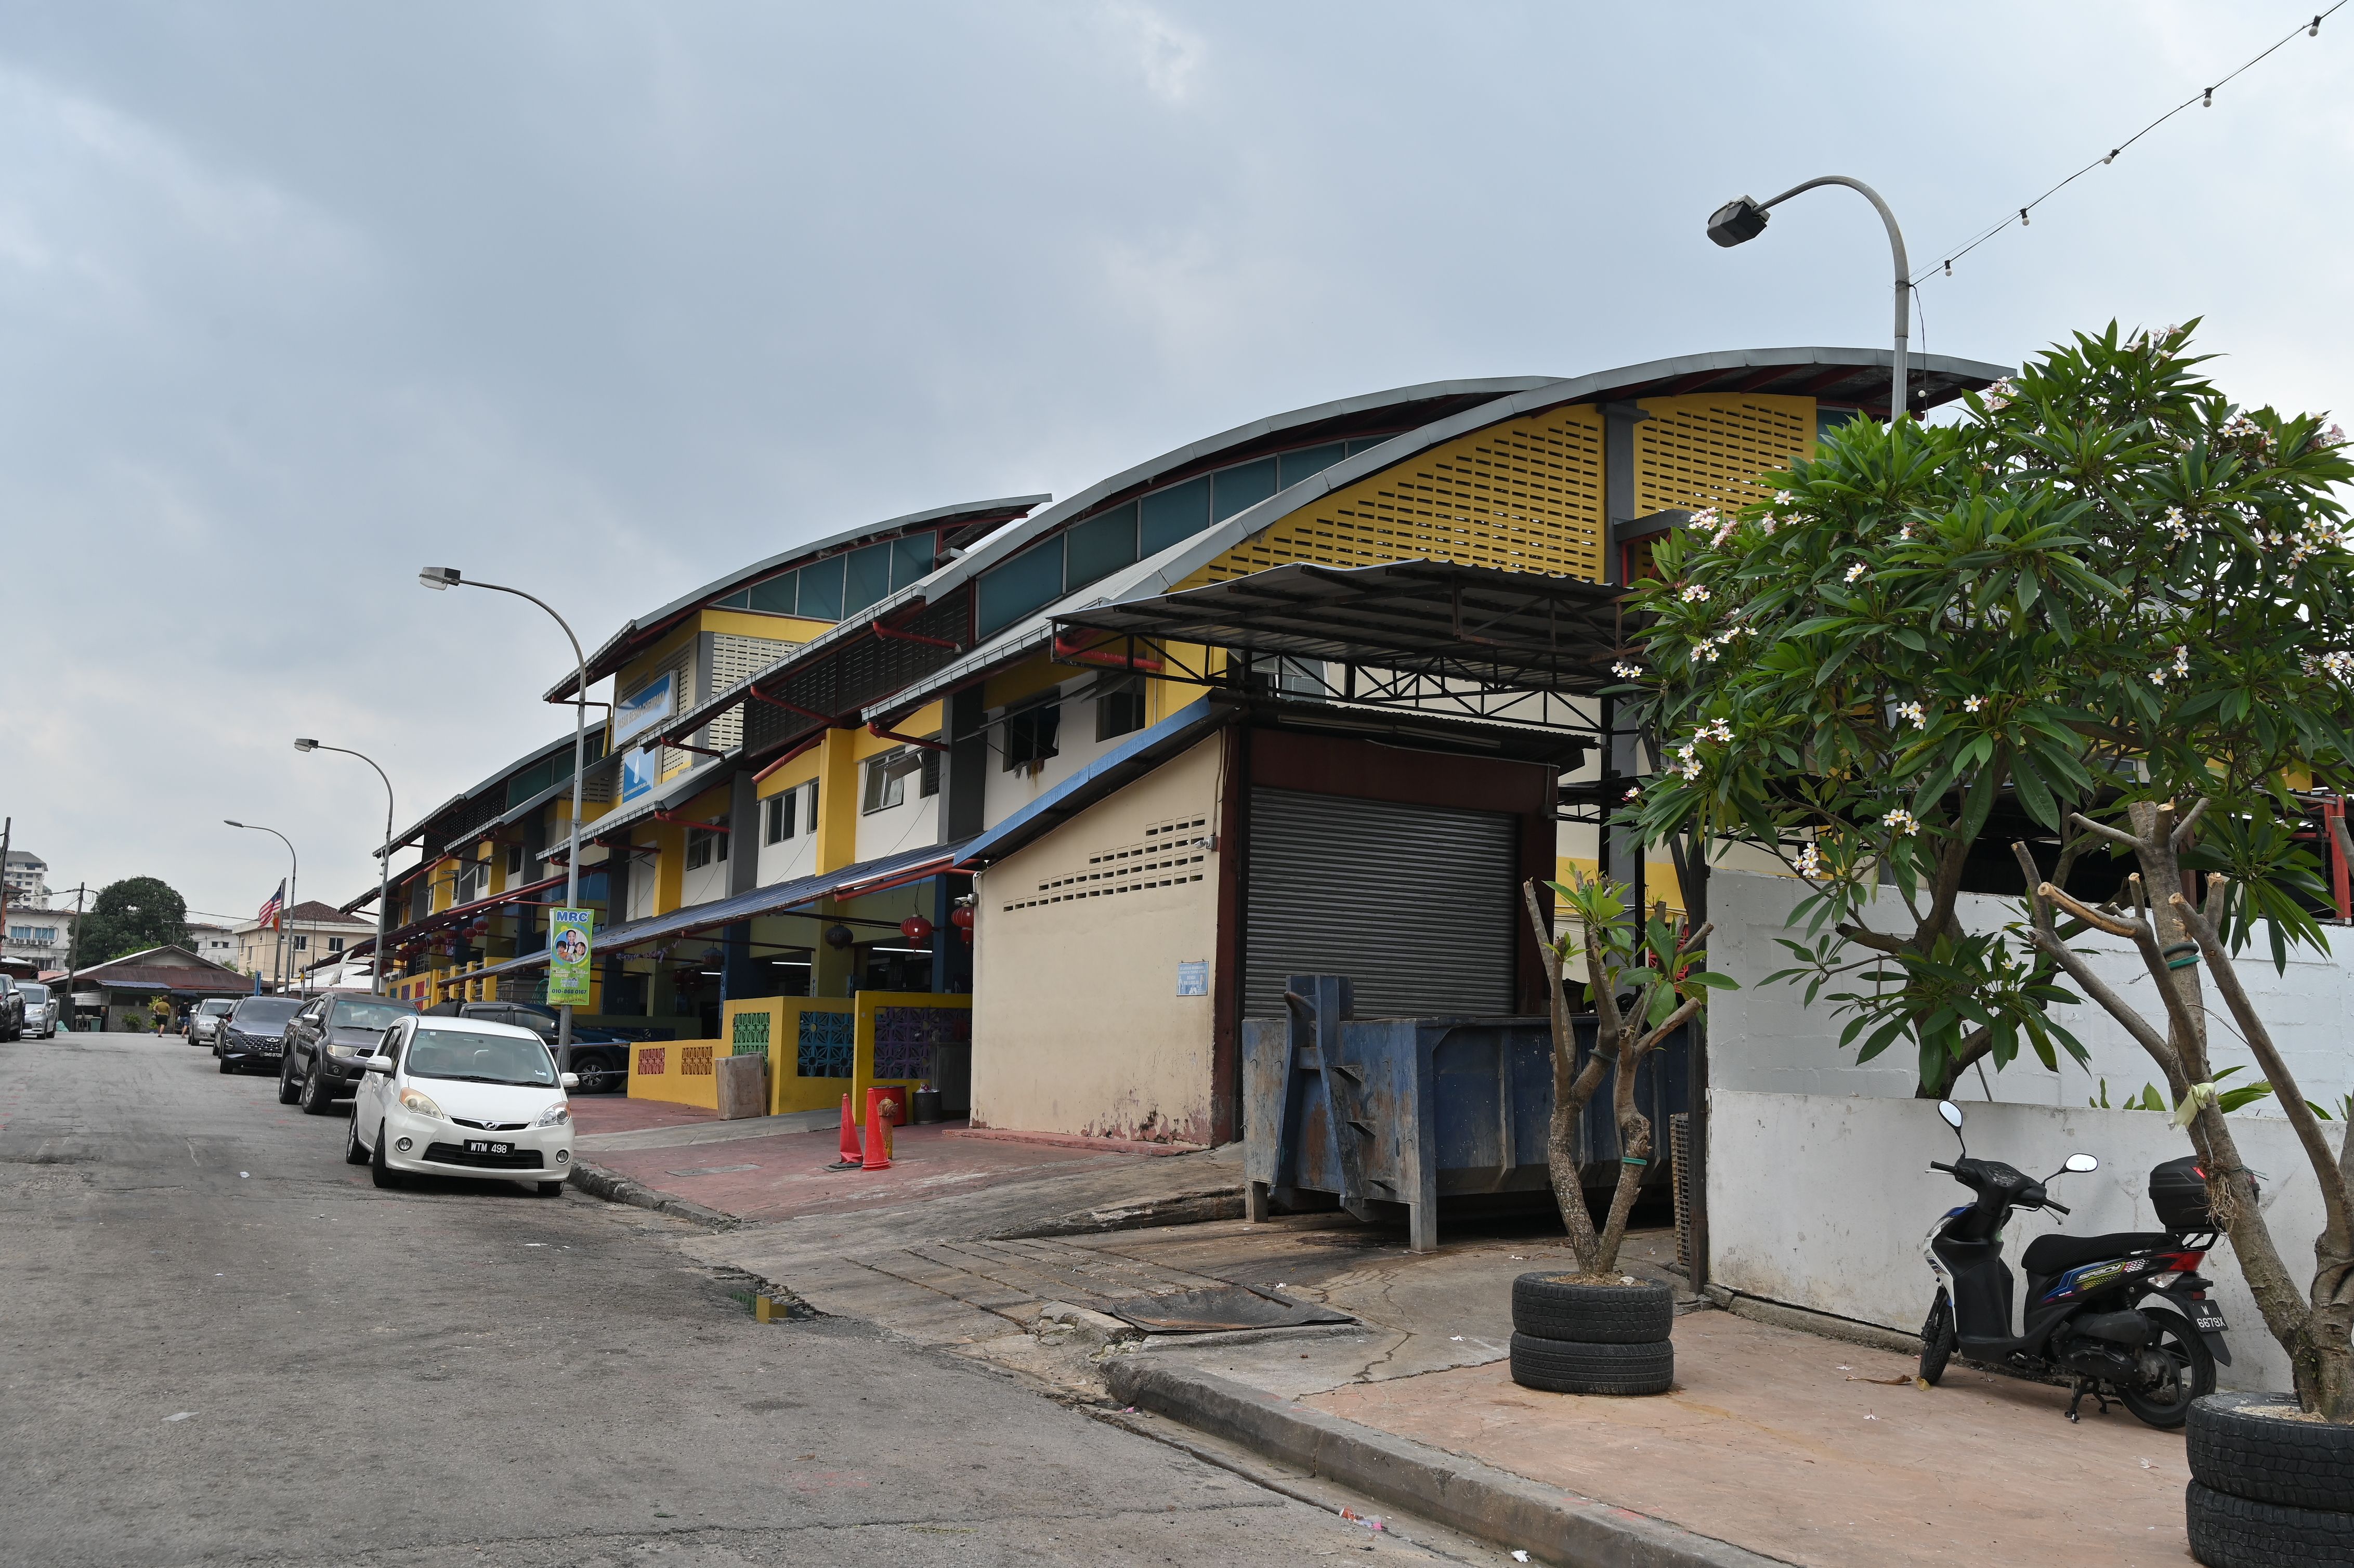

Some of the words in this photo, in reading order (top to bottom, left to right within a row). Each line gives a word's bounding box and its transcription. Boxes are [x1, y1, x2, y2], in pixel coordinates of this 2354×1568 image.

[617, 713, 629, 731] PASAR
[629, 705, 642, 724] BESAR
[642, 690, 665, 715] CHEMPAKA
[470, 1142, 488, 1152] WTM
[491, 1144, 507, 1154] 498
[2201, 1305, 2209, 1315] W
[2196, 1316, 2226, 1328] 6679X
